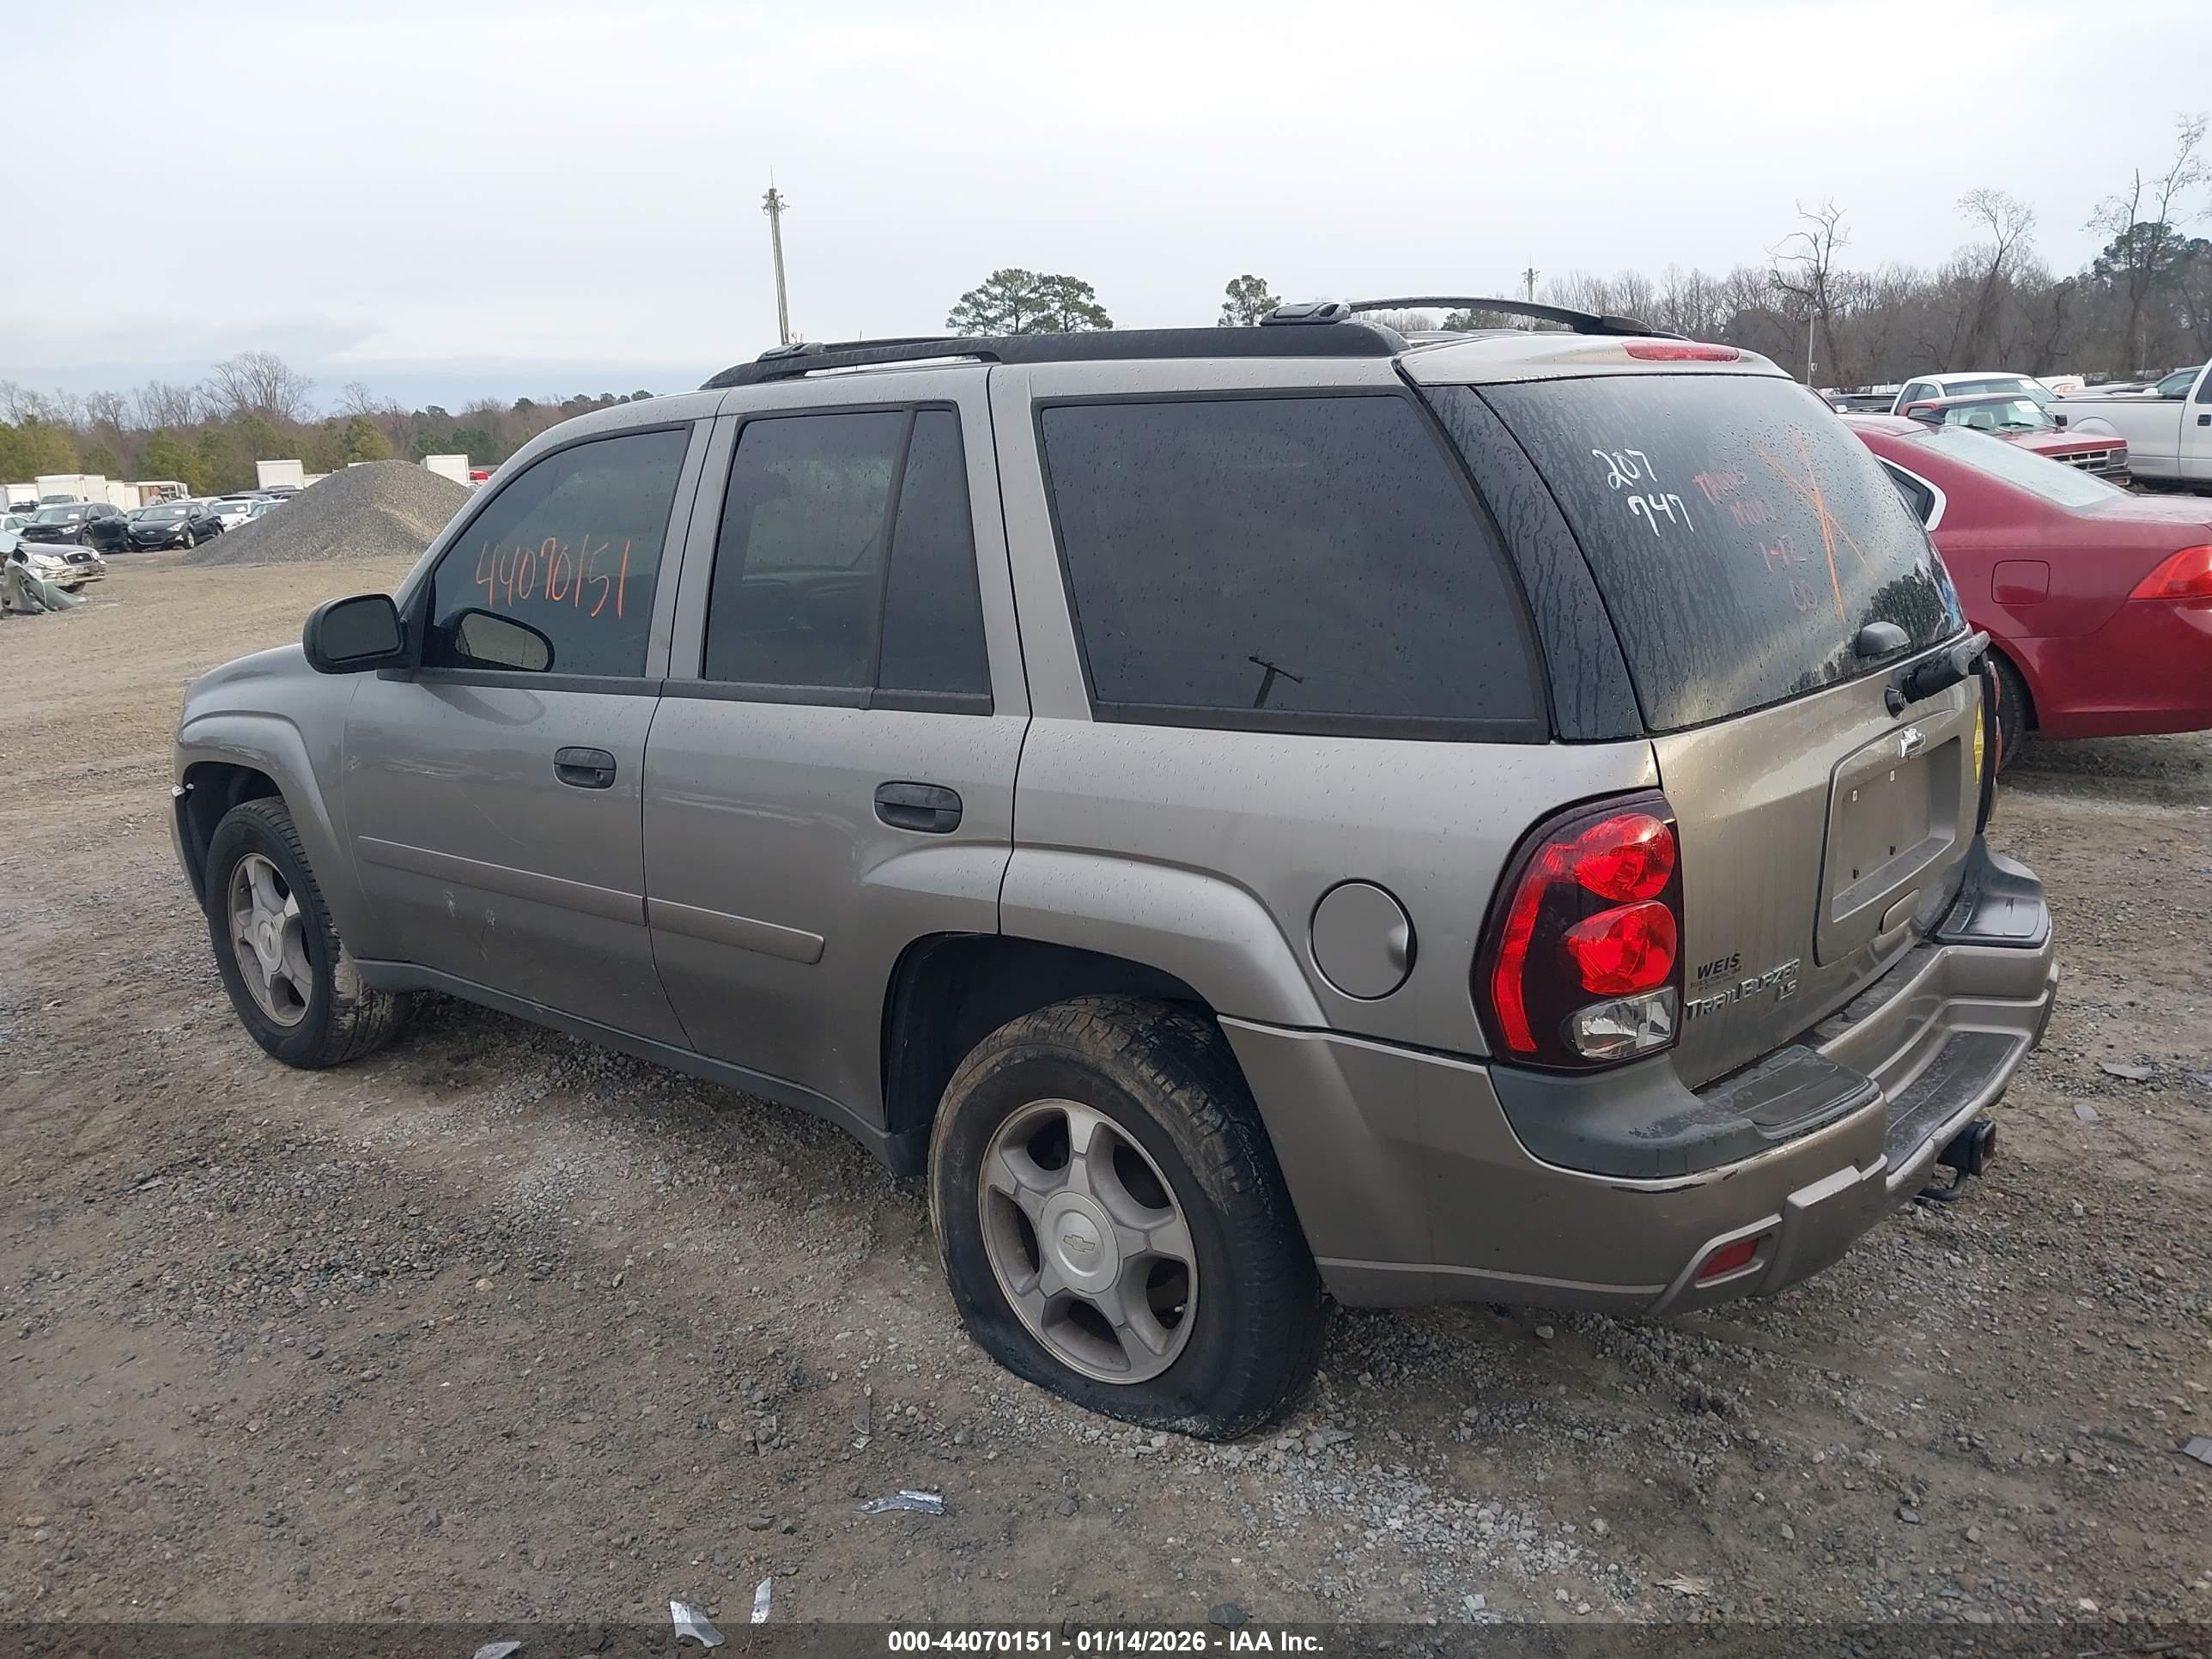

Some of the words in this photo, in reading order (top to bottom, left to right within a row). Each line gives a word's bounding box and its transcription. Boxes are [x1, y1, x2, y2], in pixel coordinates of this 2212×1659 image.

[1591, 448, 1657, 490] 207
[476, 533, 632, 619] 44070151
[1697, 952, 1741, 980] WEIS
[1775, 979, 1797, 1002] LS
